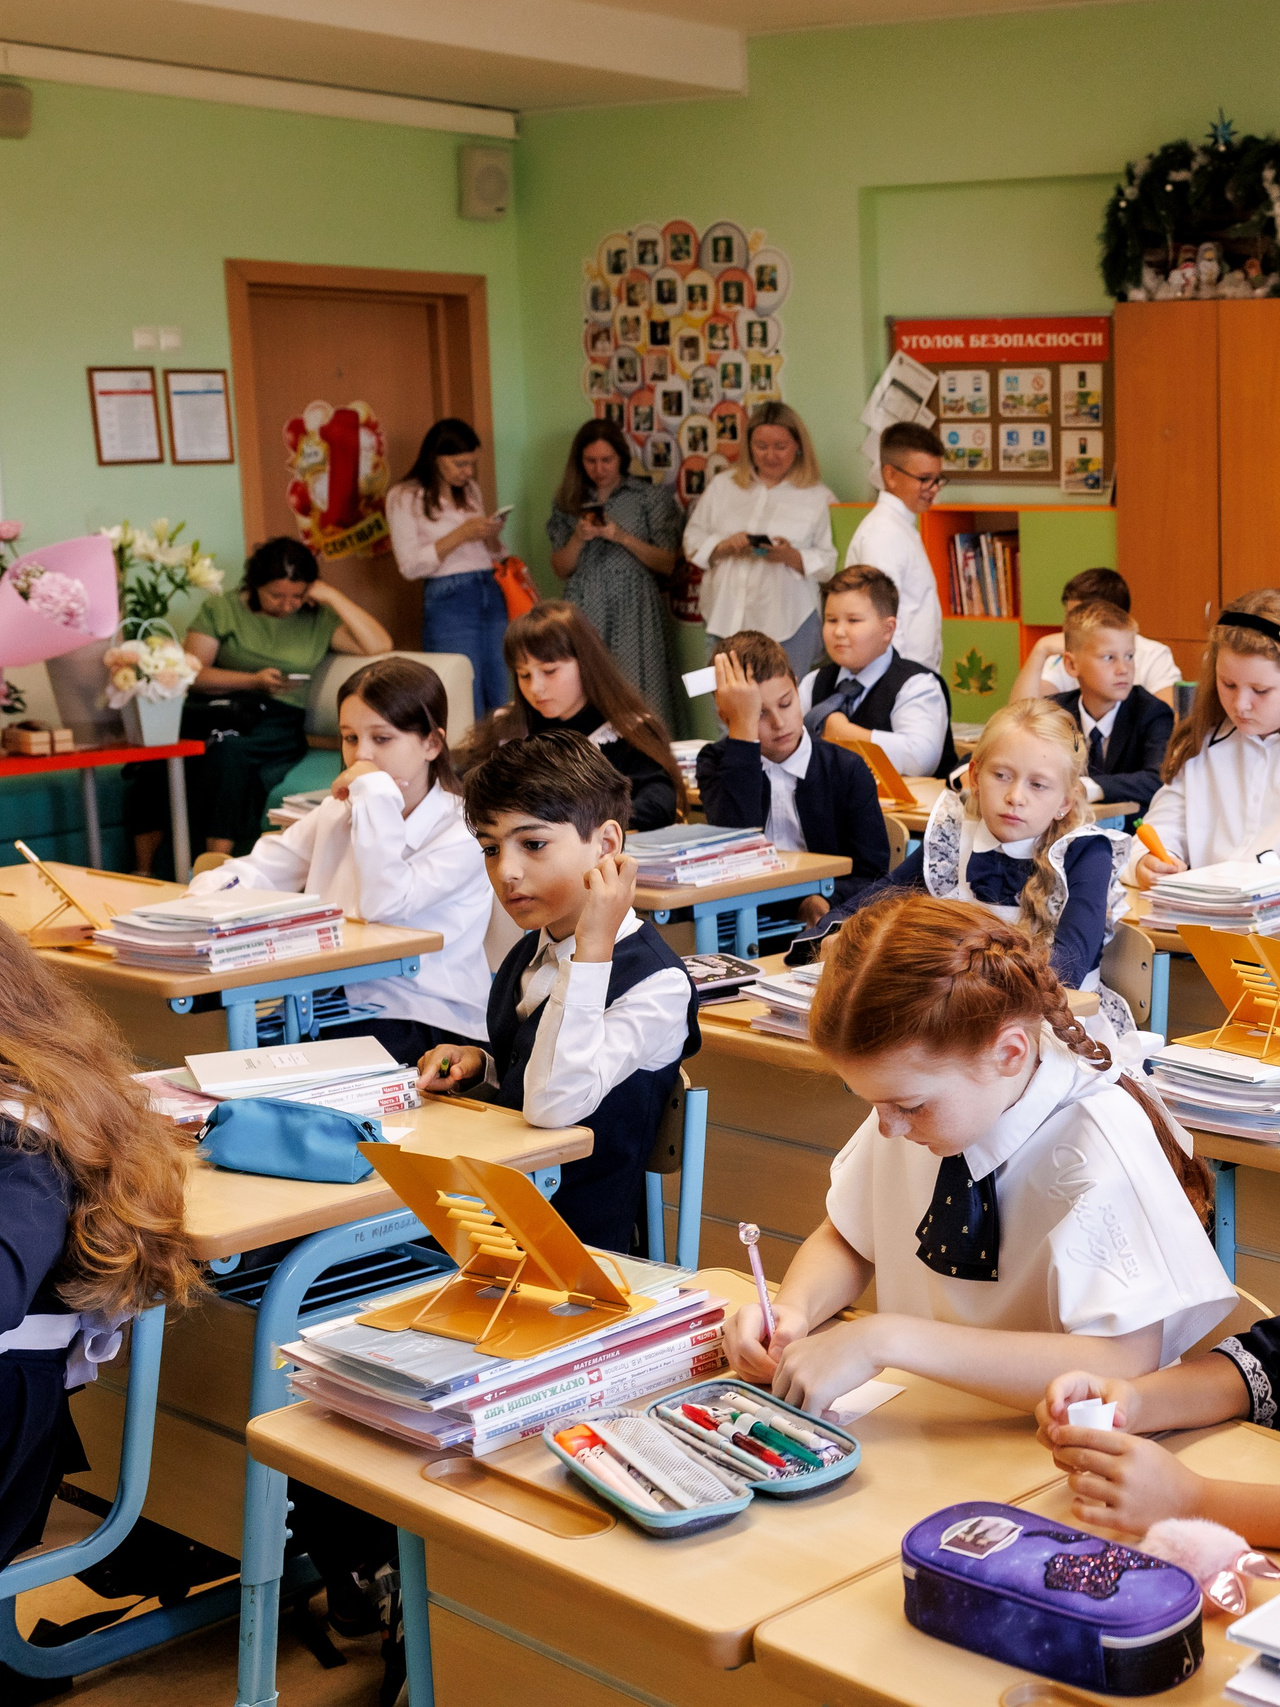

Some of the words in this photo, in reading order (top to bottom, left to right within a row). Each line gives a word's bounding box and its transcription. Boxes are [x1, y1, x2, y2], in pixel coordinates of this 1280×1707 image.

[901, 334, 965, 350] УГОЛОК
[969, 332, 1103, 348] БЕЗОПАСНОСТИ
[324, 517, 384, 557] СЕНТЯБРЯ
[383, 1086, 399, 1094] Часть
[696, 1330, 717, 1342] Часть
[573, 1350, 621, 1371] МАТЕМАТИКА
[698, 1350, 718, 1360] Часть
[697, 1361, 718, 1372] Часть
[507, 1376, 585, 1413] ОКРУЖАЮЩИЙ
[484, 1405, 506, 1420] МИР
[521, 1396, 588, 1426] ЛИТЕРАТУРНОЕ
[486, 1421, 520, 1440] ЧТЕНИЕ
